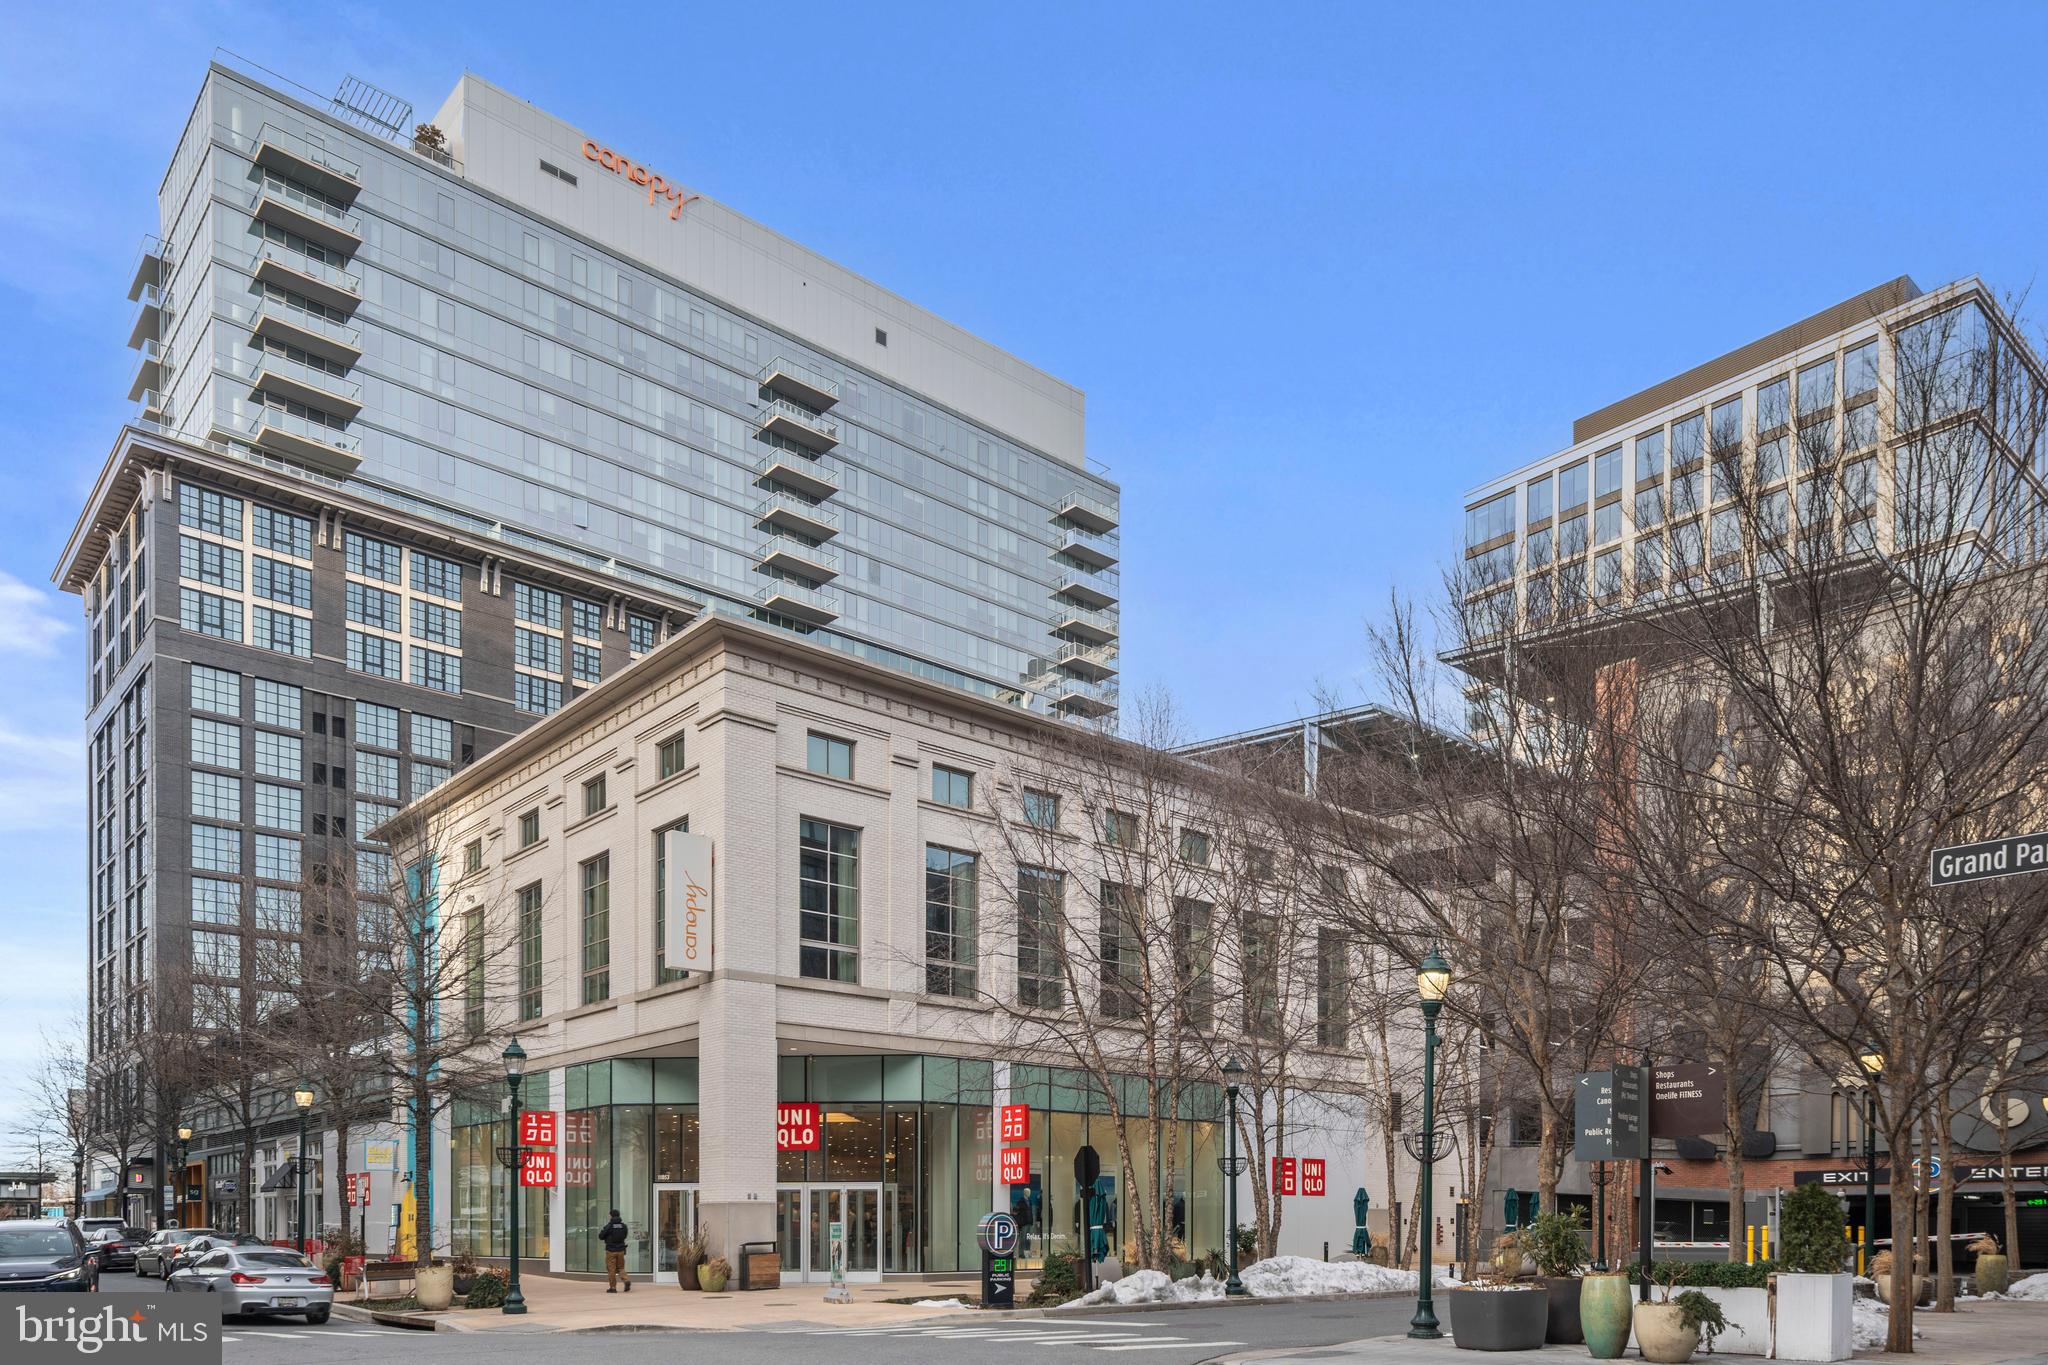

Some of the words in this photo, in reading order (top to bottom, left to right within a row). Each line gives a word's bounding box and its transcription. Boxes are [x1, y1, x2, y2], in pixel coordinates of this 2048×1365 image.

[582, 140, 699, 220] canopy
[1940, 844, 2007, 877] Grand
[2016, 843, 2048, 866] Pa
[685, 870, 708, 960] canopy
[1655, 1071, 1675, 1079] Shops
[1655, 1080, 1694, 1089] Restaurants
[1655, 1092, 1678, 1100] Onelife
[1679, 1090, 1703, 1099] FITNESS
[778, 1109, 811, 1125] UNI
[778, 1128, 814, 1148] QLO
[1585, 1128, 1603, 1136] Public
[526, 1156, 550, 1168] UNI
[1004, 1152, 1021, 1165] UNI
[526, 1170, 552, 1184] QLO
[1004, 1167, 1023, 1182] QLO
[1304, 1163, 1321, 1177] UNI
[1304, 1179, 1322, 1193] QLO
[994, 1259, 1012, 1272] 291
